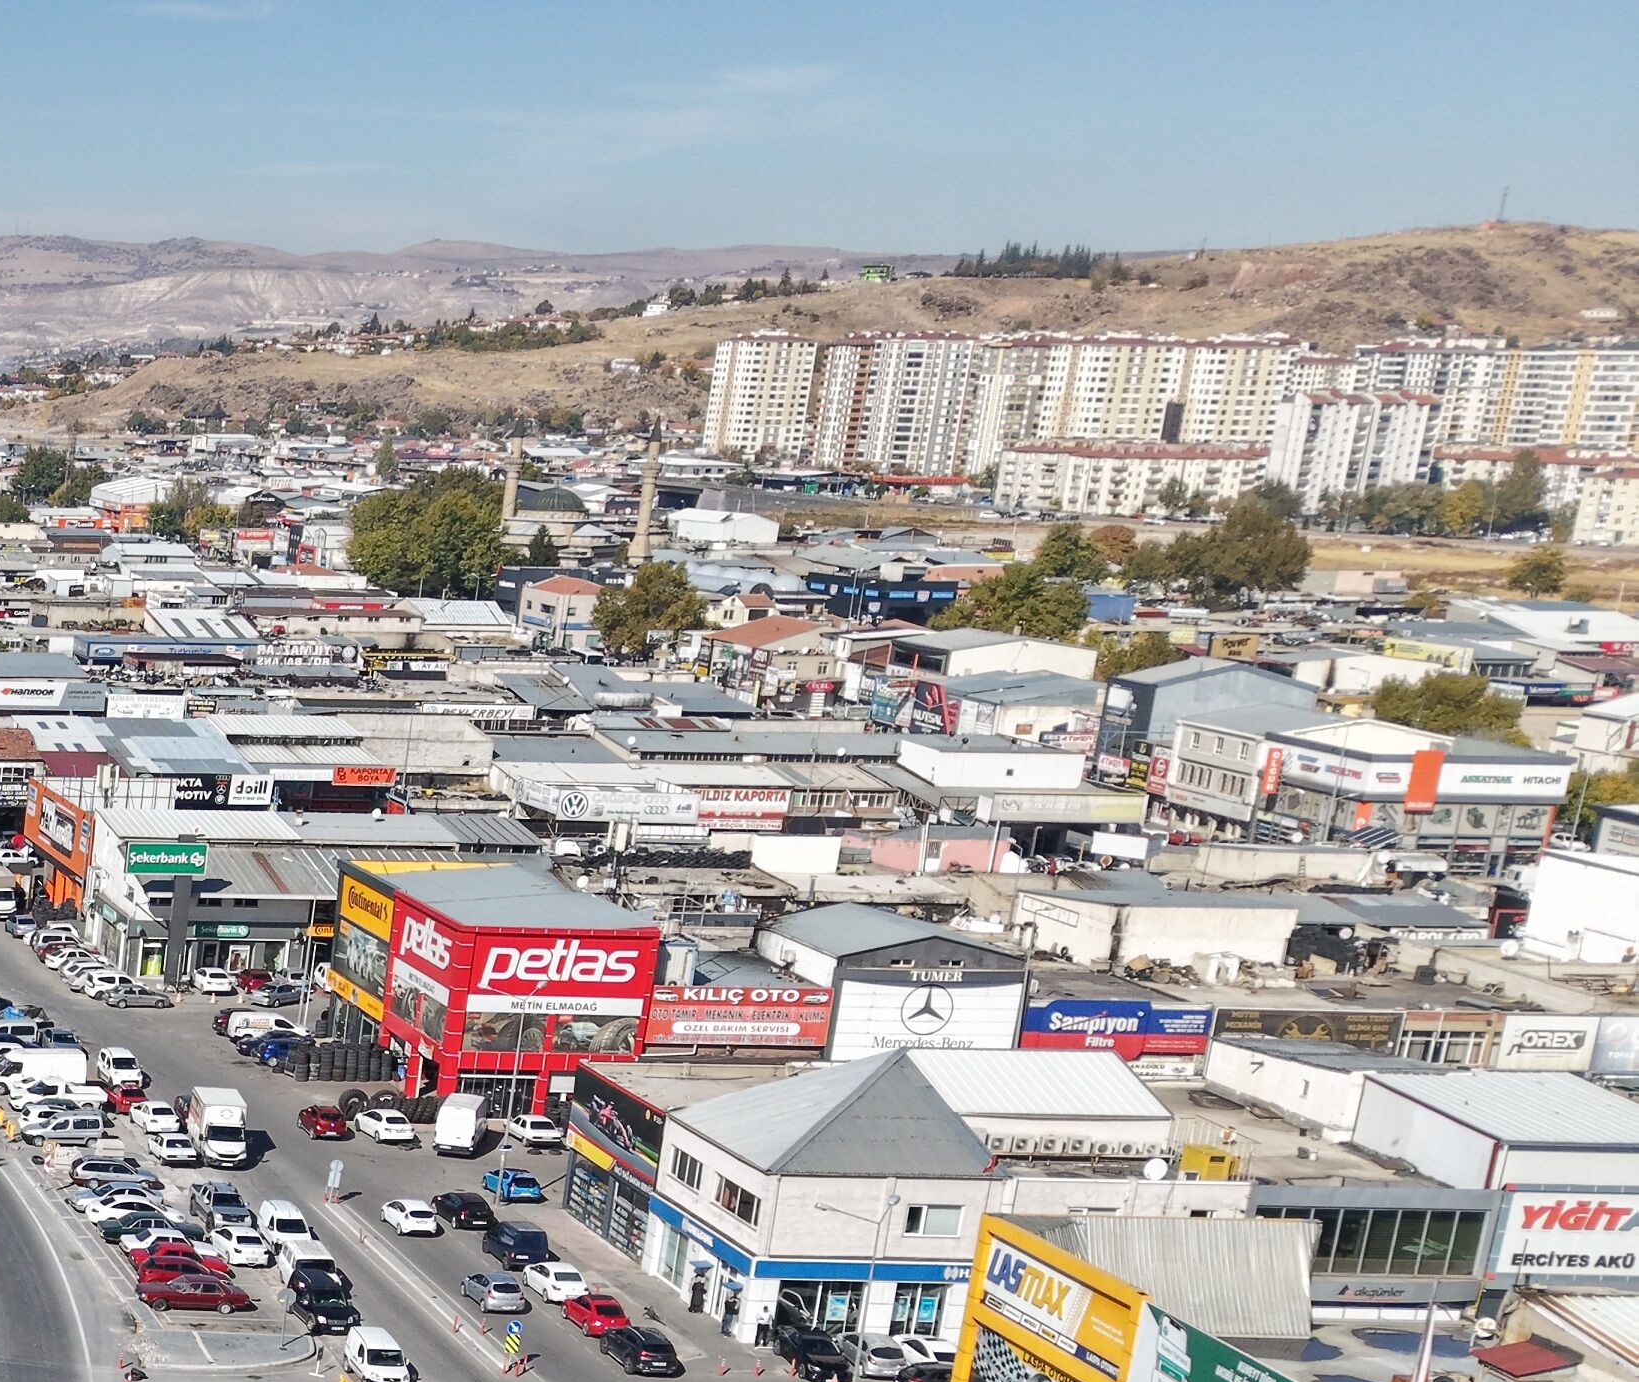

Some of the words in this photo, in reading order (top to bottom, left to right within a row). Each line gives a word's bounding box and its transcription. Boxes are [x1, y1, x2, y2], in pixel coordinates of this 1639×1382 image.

[350, 768, 389, 776] KAPORTA
[357, 775, 380, 783] BOYA
[234, 780, 268, 795] doill
[734, 790, 787, 803] KAPORTA
[127, 850, 185, 867] Şekerbank
[477, 939, 640, 990] petlas
[683, 988, 744, 1005] KILIÇ
[750, 989, 800, 1003] OTO
[511, 1000, 543, 1012] METİN
[546, 999, 598, 1013] ELMADAĞ
[714, 1024, 749, 1034] BAKIM
[872, 1036, 974, 1050] Mercedes-Benz
[1084, 1037, 1115, 1049] Filtre
[1521, 1199, 1634, 1232] YİĞİT
[1510, 1250, 1591, 1268] ERCİYES
[1593, 1252, 1637, 1269] AKÜ
